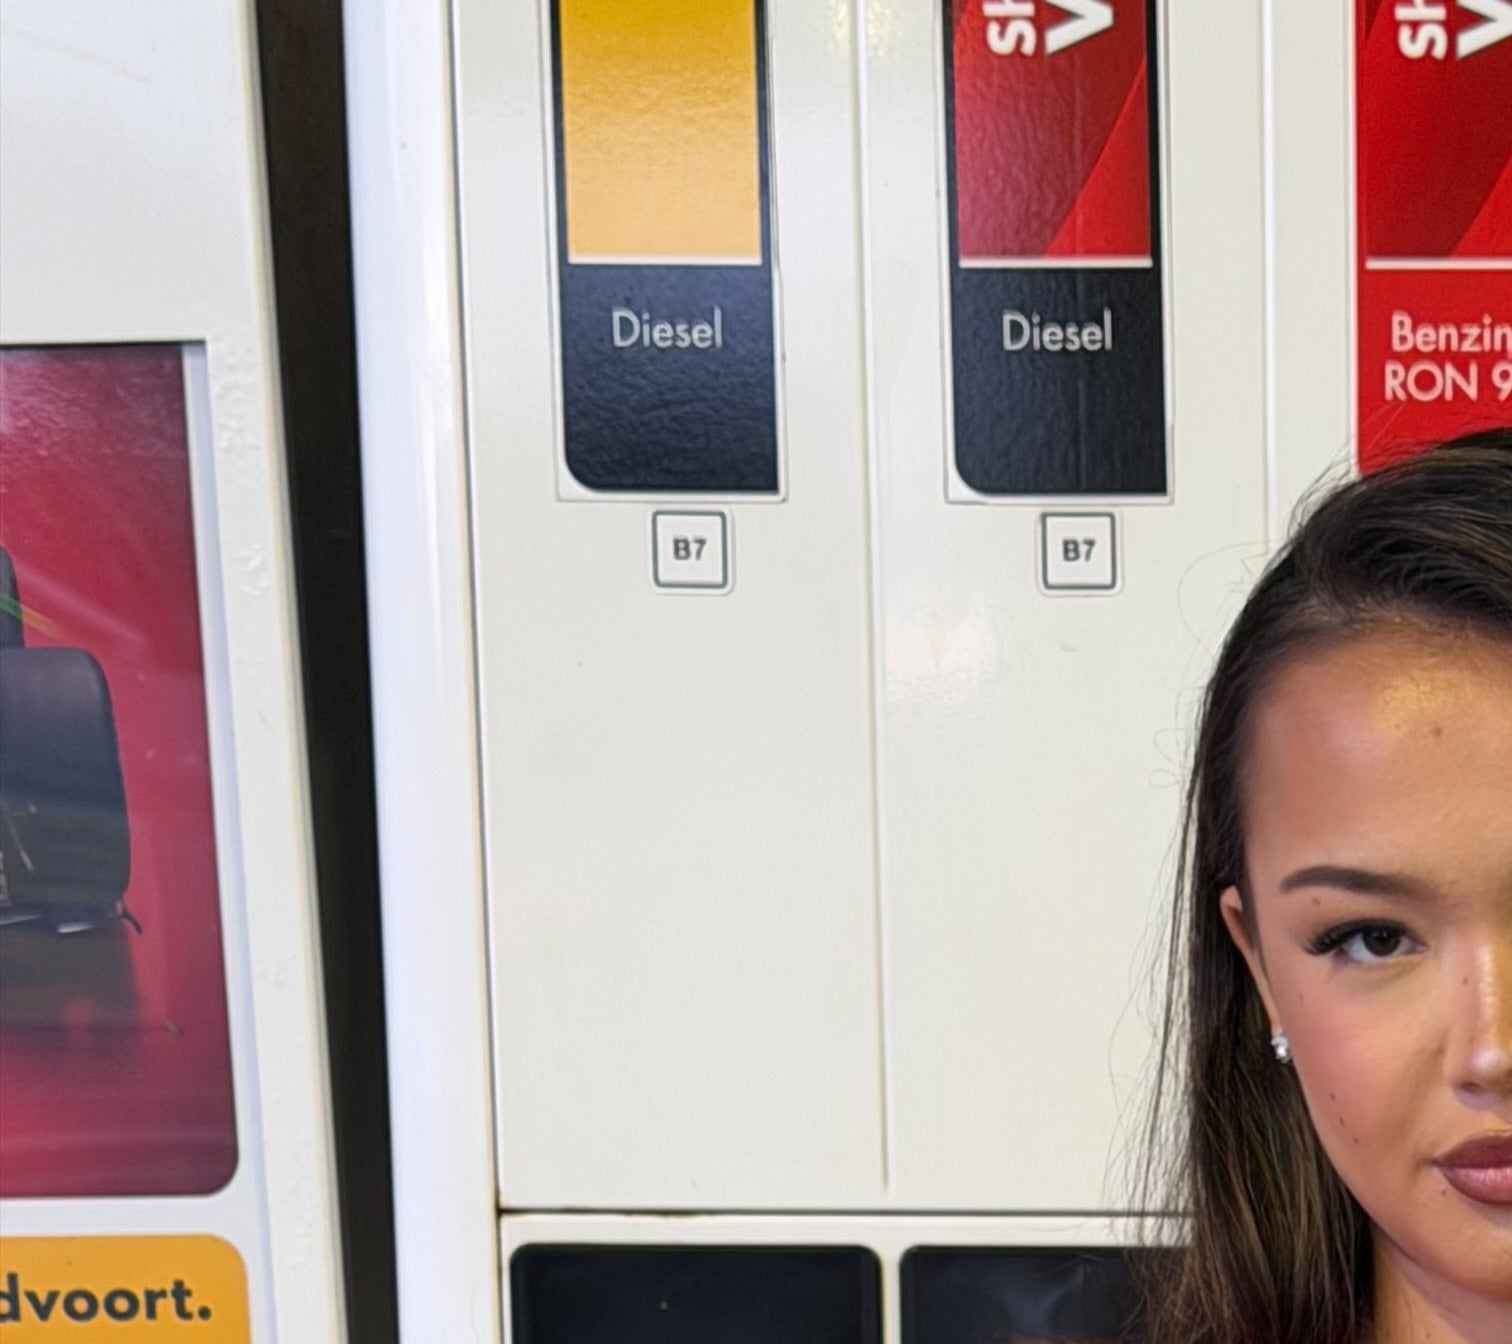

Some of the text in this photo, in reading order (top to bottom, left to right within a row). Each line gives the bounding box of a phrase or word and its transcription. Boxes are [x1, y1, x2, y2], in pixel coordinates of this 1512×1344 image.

[612, 306, 722, 348] Diesel
[1003, 310, 1111, 351] Diesel
[1385, 361, 1478, 402] RON
[673, 537, 707, 561] B7
[1062, 538, 1096, 562] B7
